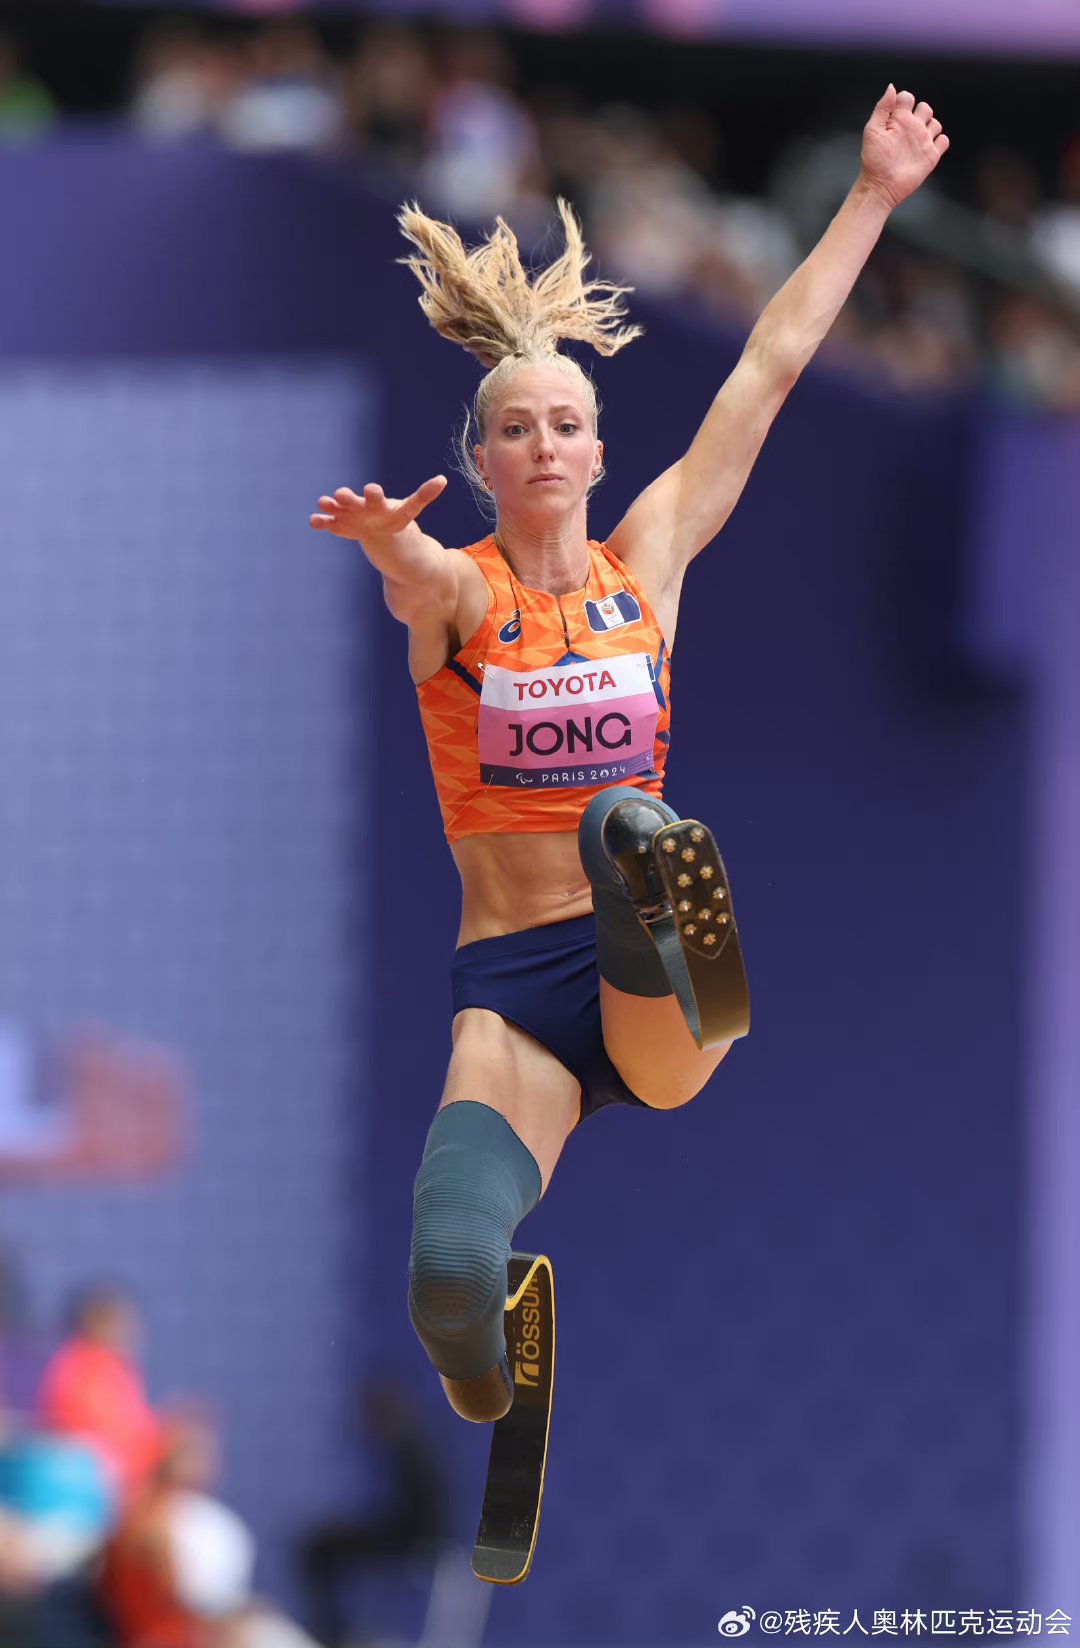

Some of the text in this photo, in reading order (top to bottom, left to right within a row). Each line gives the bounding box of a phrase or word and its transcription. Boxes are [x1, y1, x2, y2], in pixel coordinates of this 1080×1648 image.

[513, 670, 617, 701] TOYOTA
[508, 712, 632, 757] JONG
[541, 765, 626, 783] PARIS 2024
